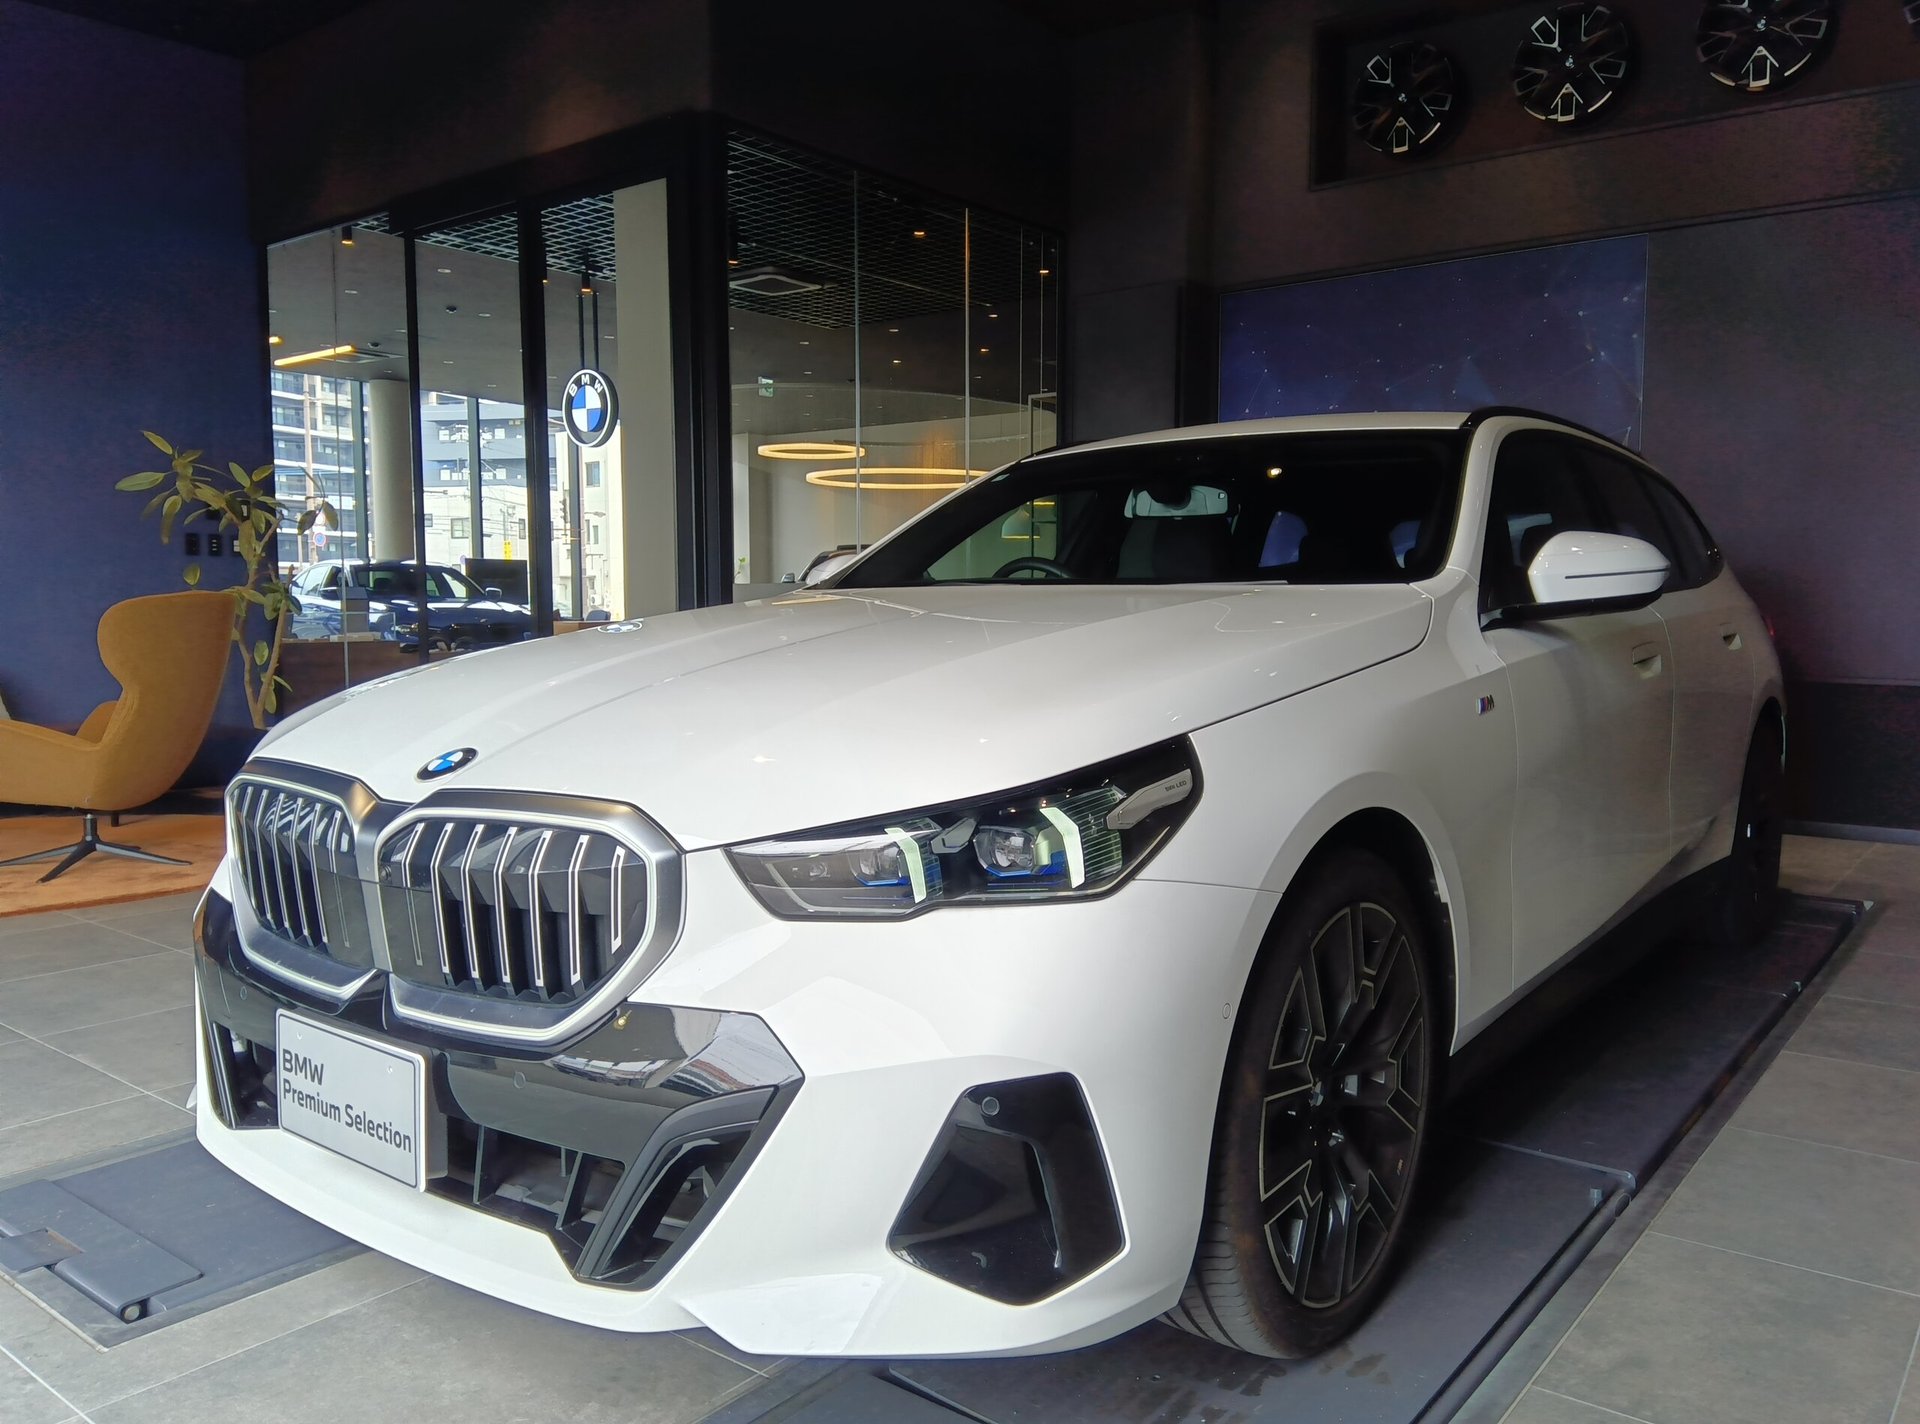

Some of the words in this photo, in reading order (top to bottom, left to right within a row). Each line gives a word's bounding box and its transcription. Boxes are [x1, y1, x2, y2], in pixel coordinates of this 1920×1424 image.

[568, 374, 604, 397] BMW
[282, 1048, 324, 1086] BMW
[283, 1078, 341, 1123] Premium
[344, 1103, 412, 1153] Selection
